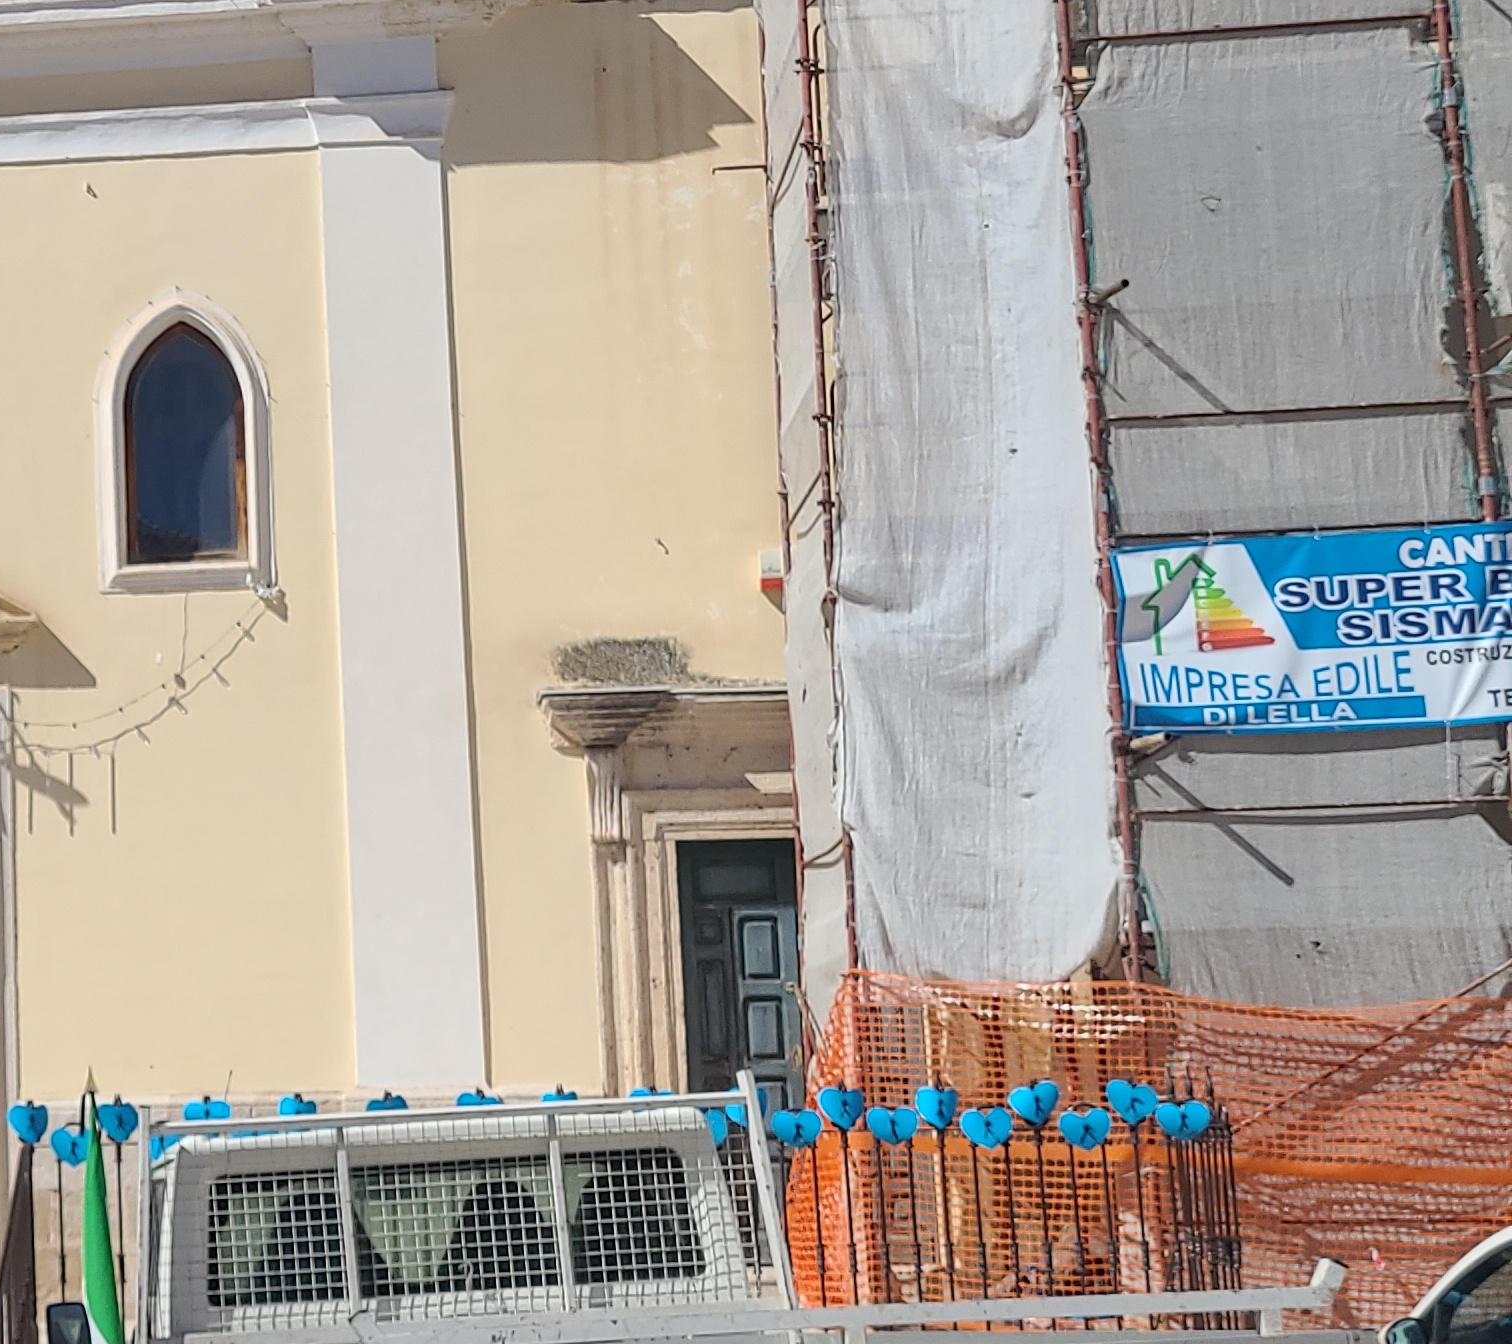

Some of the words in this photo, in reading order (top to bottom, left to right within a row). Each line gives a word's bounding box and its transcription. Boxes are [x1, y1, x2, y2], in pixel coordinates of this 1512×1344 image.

[1276, 571, 1469, 609] SUPER
[1339, 603, 1512, 643] SISMA
[1139, 662, 1301, 704] IMPRESA
[1313, 650, 1415, 697] EDILE
[1202, 706, 1237, 726] DI
[1246, 701, 1358, 725] LELLA
